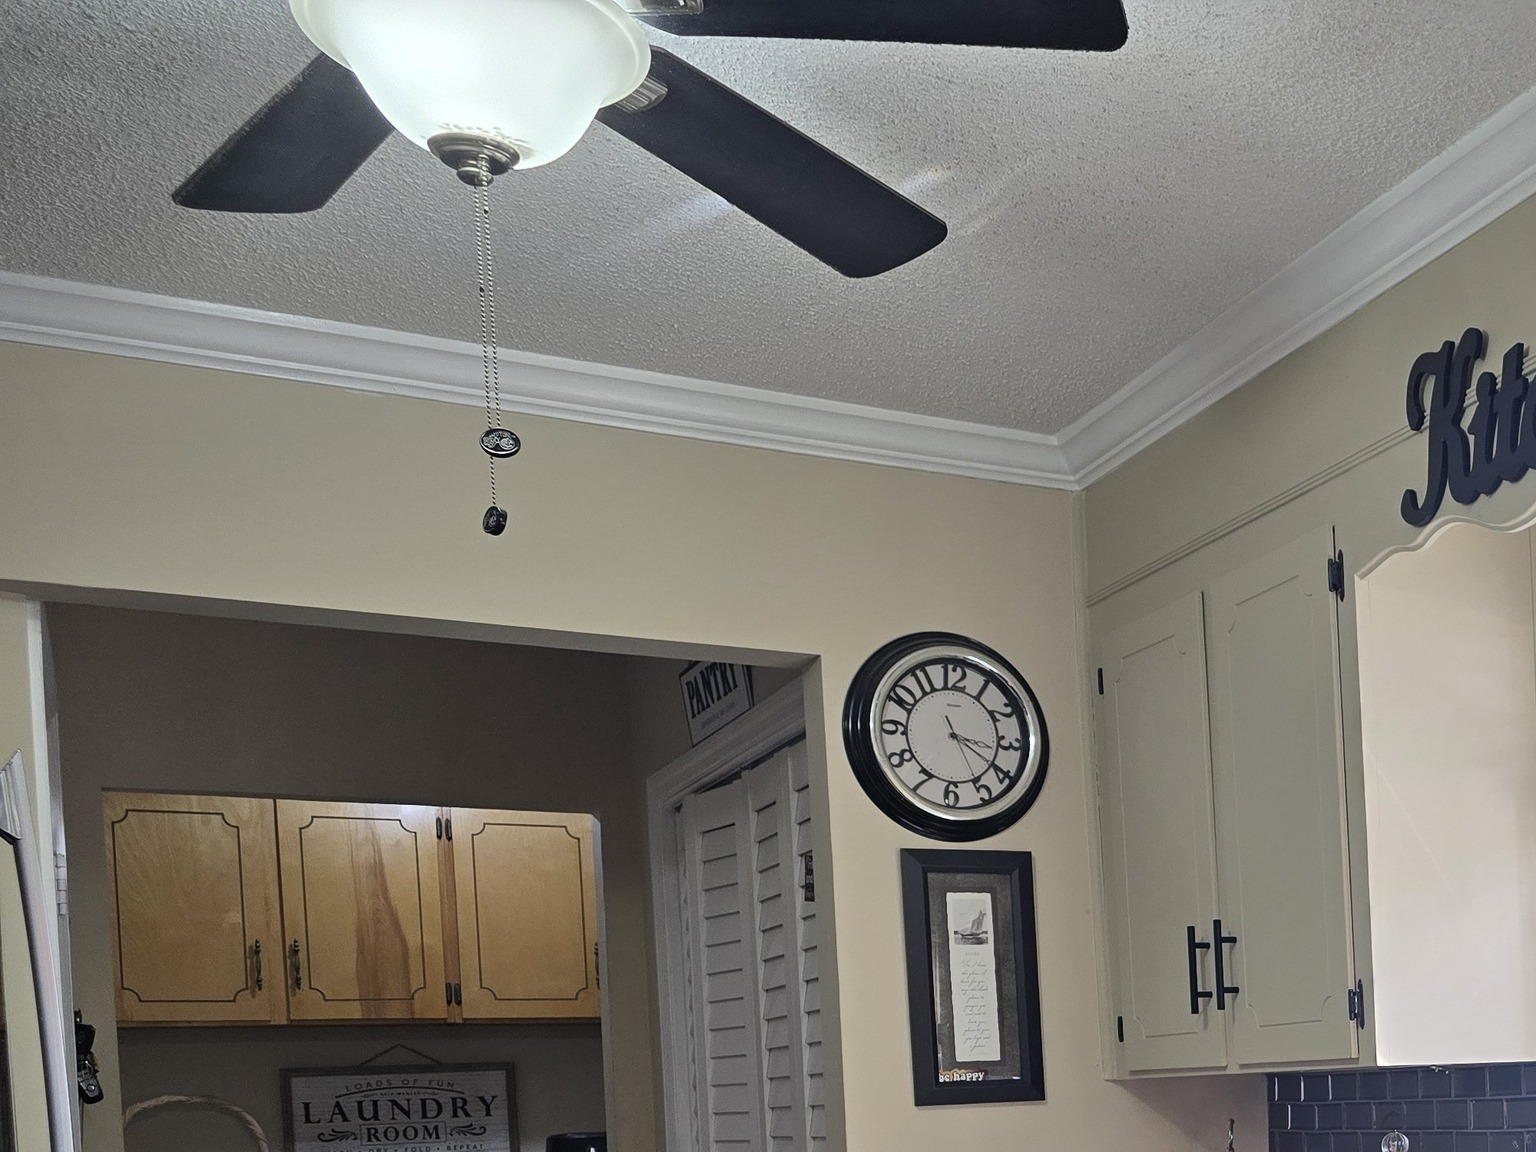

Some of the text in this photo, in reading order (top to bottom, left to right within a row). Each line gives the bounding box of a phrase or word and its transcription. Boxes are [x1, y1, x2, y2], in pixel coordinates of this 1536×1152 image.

[911, 667, 936, 697] 11
[941, 664, 968, 692] 12
[888, 684, 917, 712] 10
[975, 679, 991, 700] 1
[988, 702, 1014, 723] 2
[881, 719, 906, 736] 9
[998, 735, 1022, 752] 3
[888, 748, 914, 768] 8
[912, 766, 935, 792] 7
[991, 762, 1014, 785] 4
[943, 782, 960, 808] 6
[972, 776, 993, 803] 5
[345, 1078, 455, 1092] LOADS OF FUN
[953, 1071, 985, 1082] happy
[301, 1095, 498, 1124] LAUNDRY
[366, 1125, 441, 1143] ROOM
[446, 1143, 484, 1151] REPEAT
